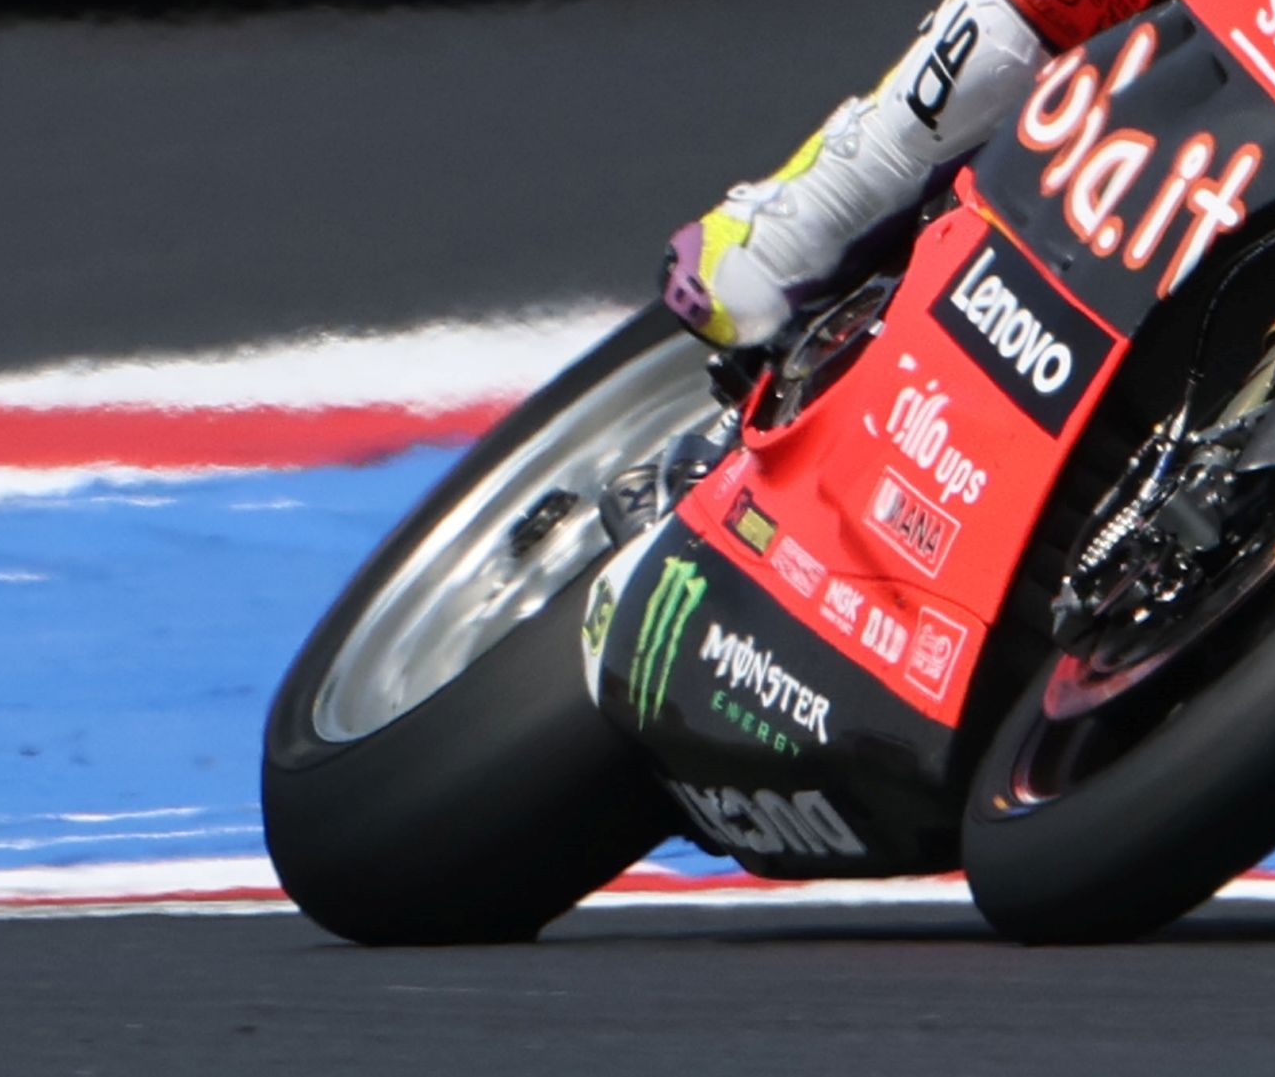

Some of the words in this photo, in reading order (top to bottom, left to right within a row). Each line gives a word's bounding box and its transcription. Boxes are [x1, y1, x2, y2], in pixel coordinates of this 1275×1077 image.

[1018, 23, 1262, 300] uba.it
[950, 246, 1072, 395] Lenovo
[935, 443, 988, 505] ups
[824, 578, 865, 623] NGK
[711, 691, 801, 757] ENERGY
